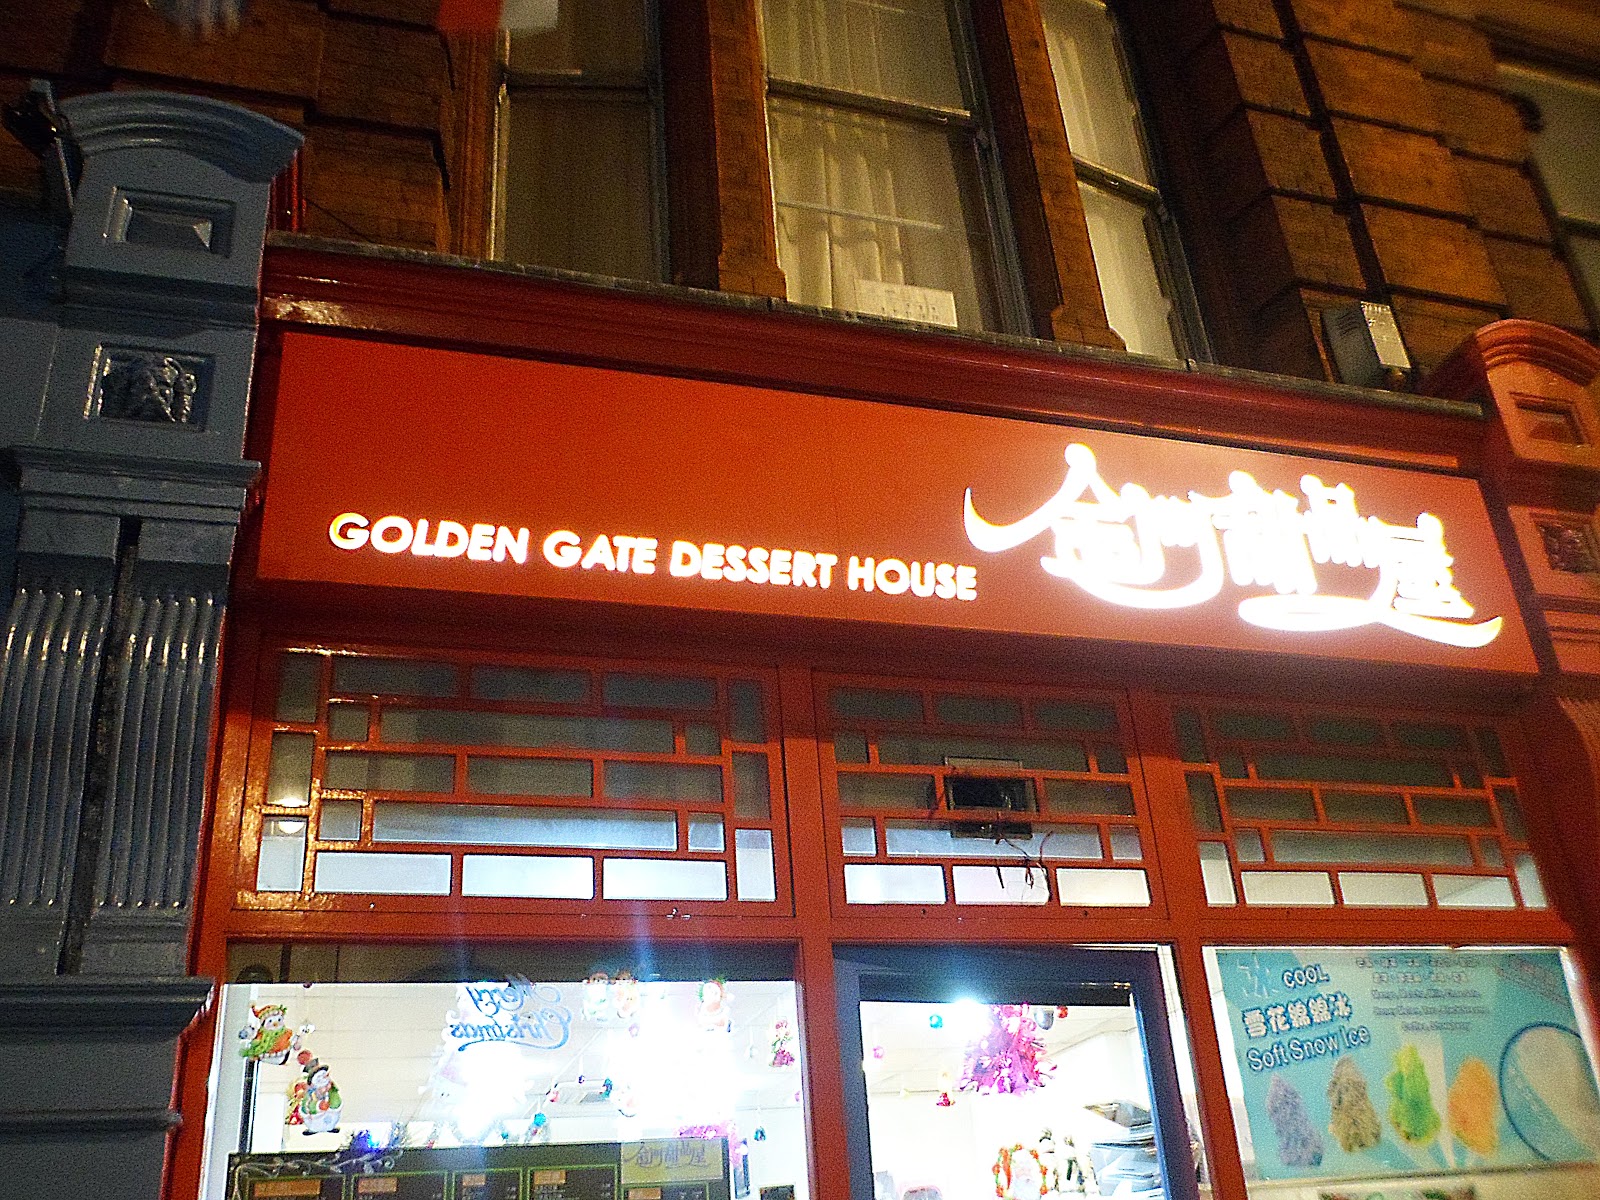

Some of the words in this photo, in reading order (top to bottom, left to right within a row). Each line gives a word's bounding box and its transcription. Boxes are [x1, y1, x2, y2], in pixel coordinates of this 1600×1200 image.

[328, 511, 531, 565] GOLDEN
[542, 529, 660, 575] GATE
[668, 539, 839, 589] DESSERT
[846, 555, 979, 602] HOUSE
[1282, 964, 1330, 989] COOL
[1247, 1041, 1291, 1071] Soft
[1289, 1031, 1340, 1062] Snow
[1340, 1025, 1371, 1050] Ice
